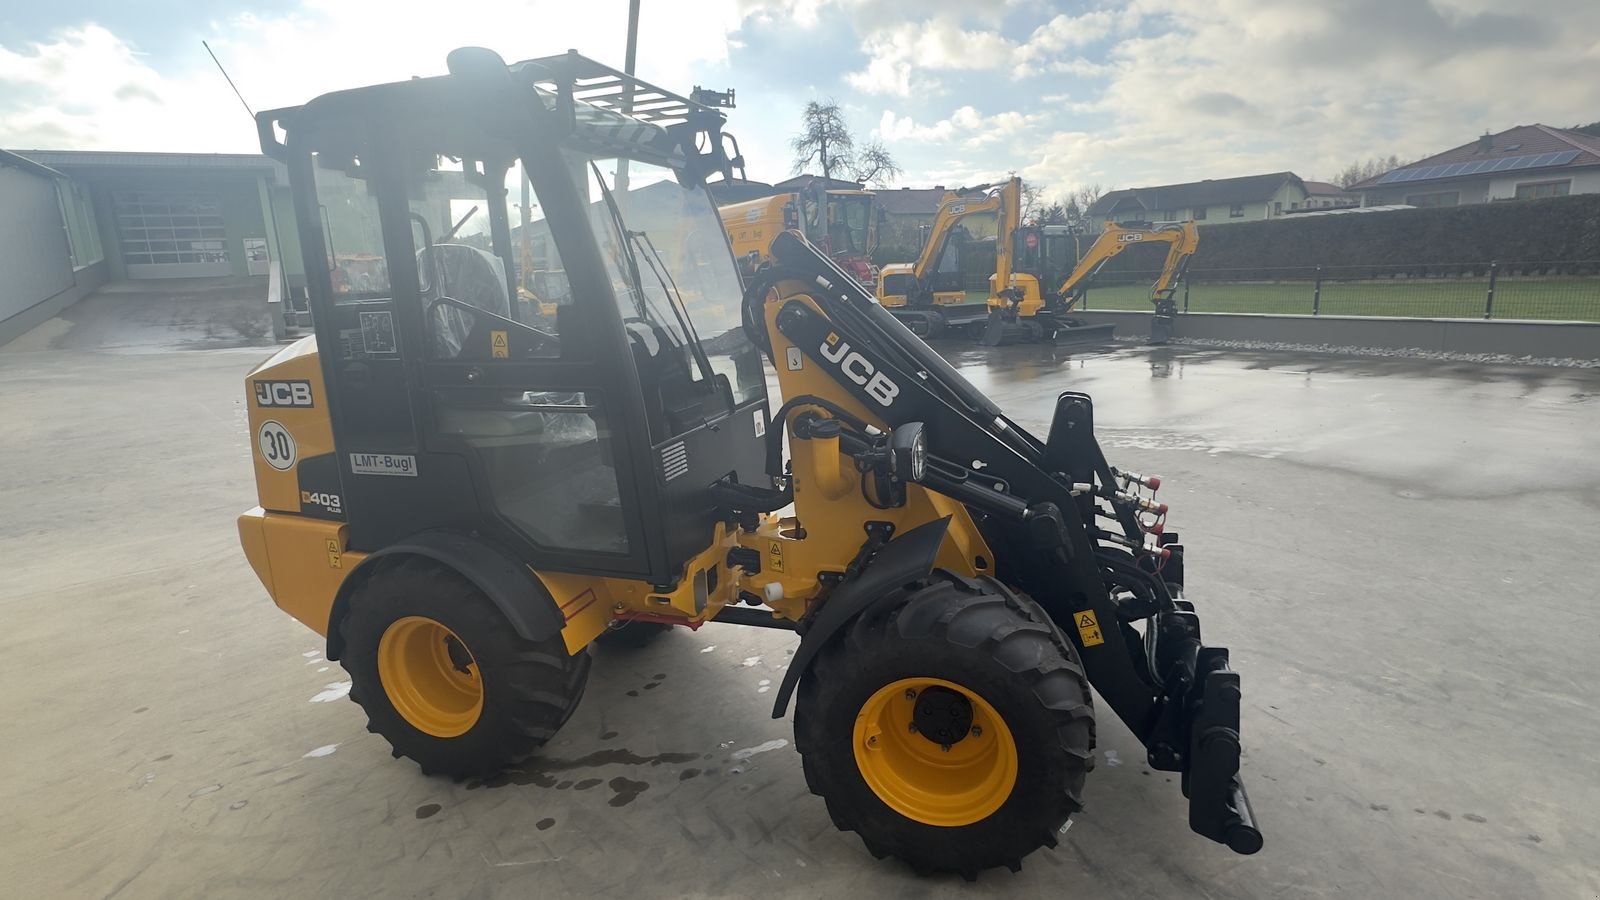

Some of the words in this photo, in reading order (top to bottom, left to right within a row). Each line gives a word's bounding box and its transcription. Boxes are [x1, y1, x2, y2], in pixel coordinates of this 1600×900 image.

[949, 204, 965, 214] JCB
[1118, 233, 1143, 242] JCB
[819, 341, 900, 407] JCB
[257, 383, 312, 405] JCB
[264, 430, 291, 461] 30
[353, 455, 413, 471] LMT-Bugl
[310, 492, 340, 507] 403
